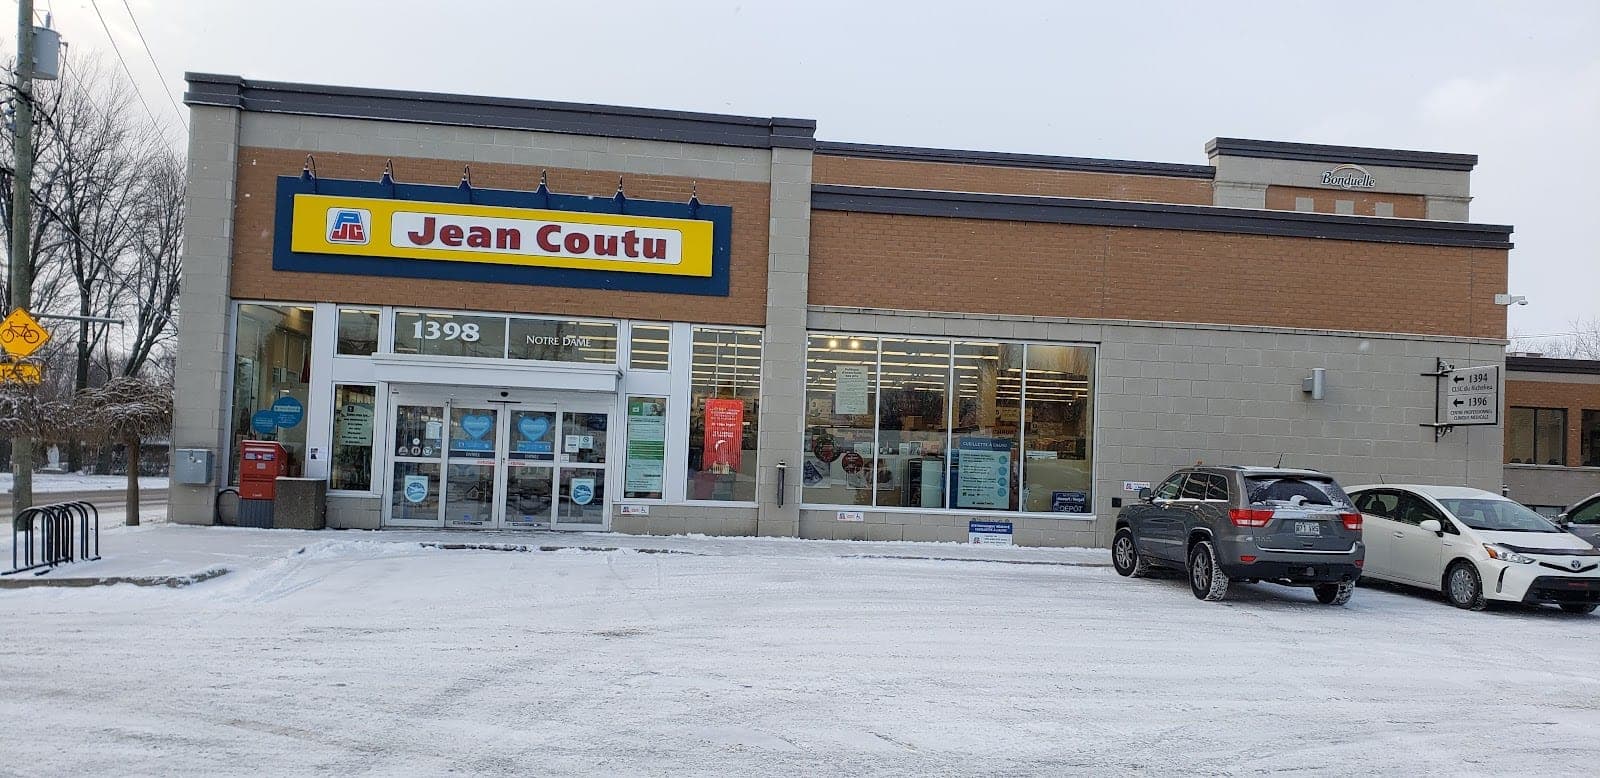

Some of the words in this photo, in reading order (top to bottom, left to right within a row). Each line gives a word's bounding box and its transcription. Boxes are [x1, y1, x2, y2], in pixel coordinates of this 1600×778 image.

[1322, 171, 1375, 189] Bonduelle
[407, 216, 521, 250] Jean
[536, 224, 668, 260] Coutu
[412, 319, 480, 343] 1398
[526, 335, 560, 347] NOTRE
[562, 336, 592, 348] DAME
[1469, 373, 1488, 383] 1394
[1468, 397, 1488, 407] 1396
